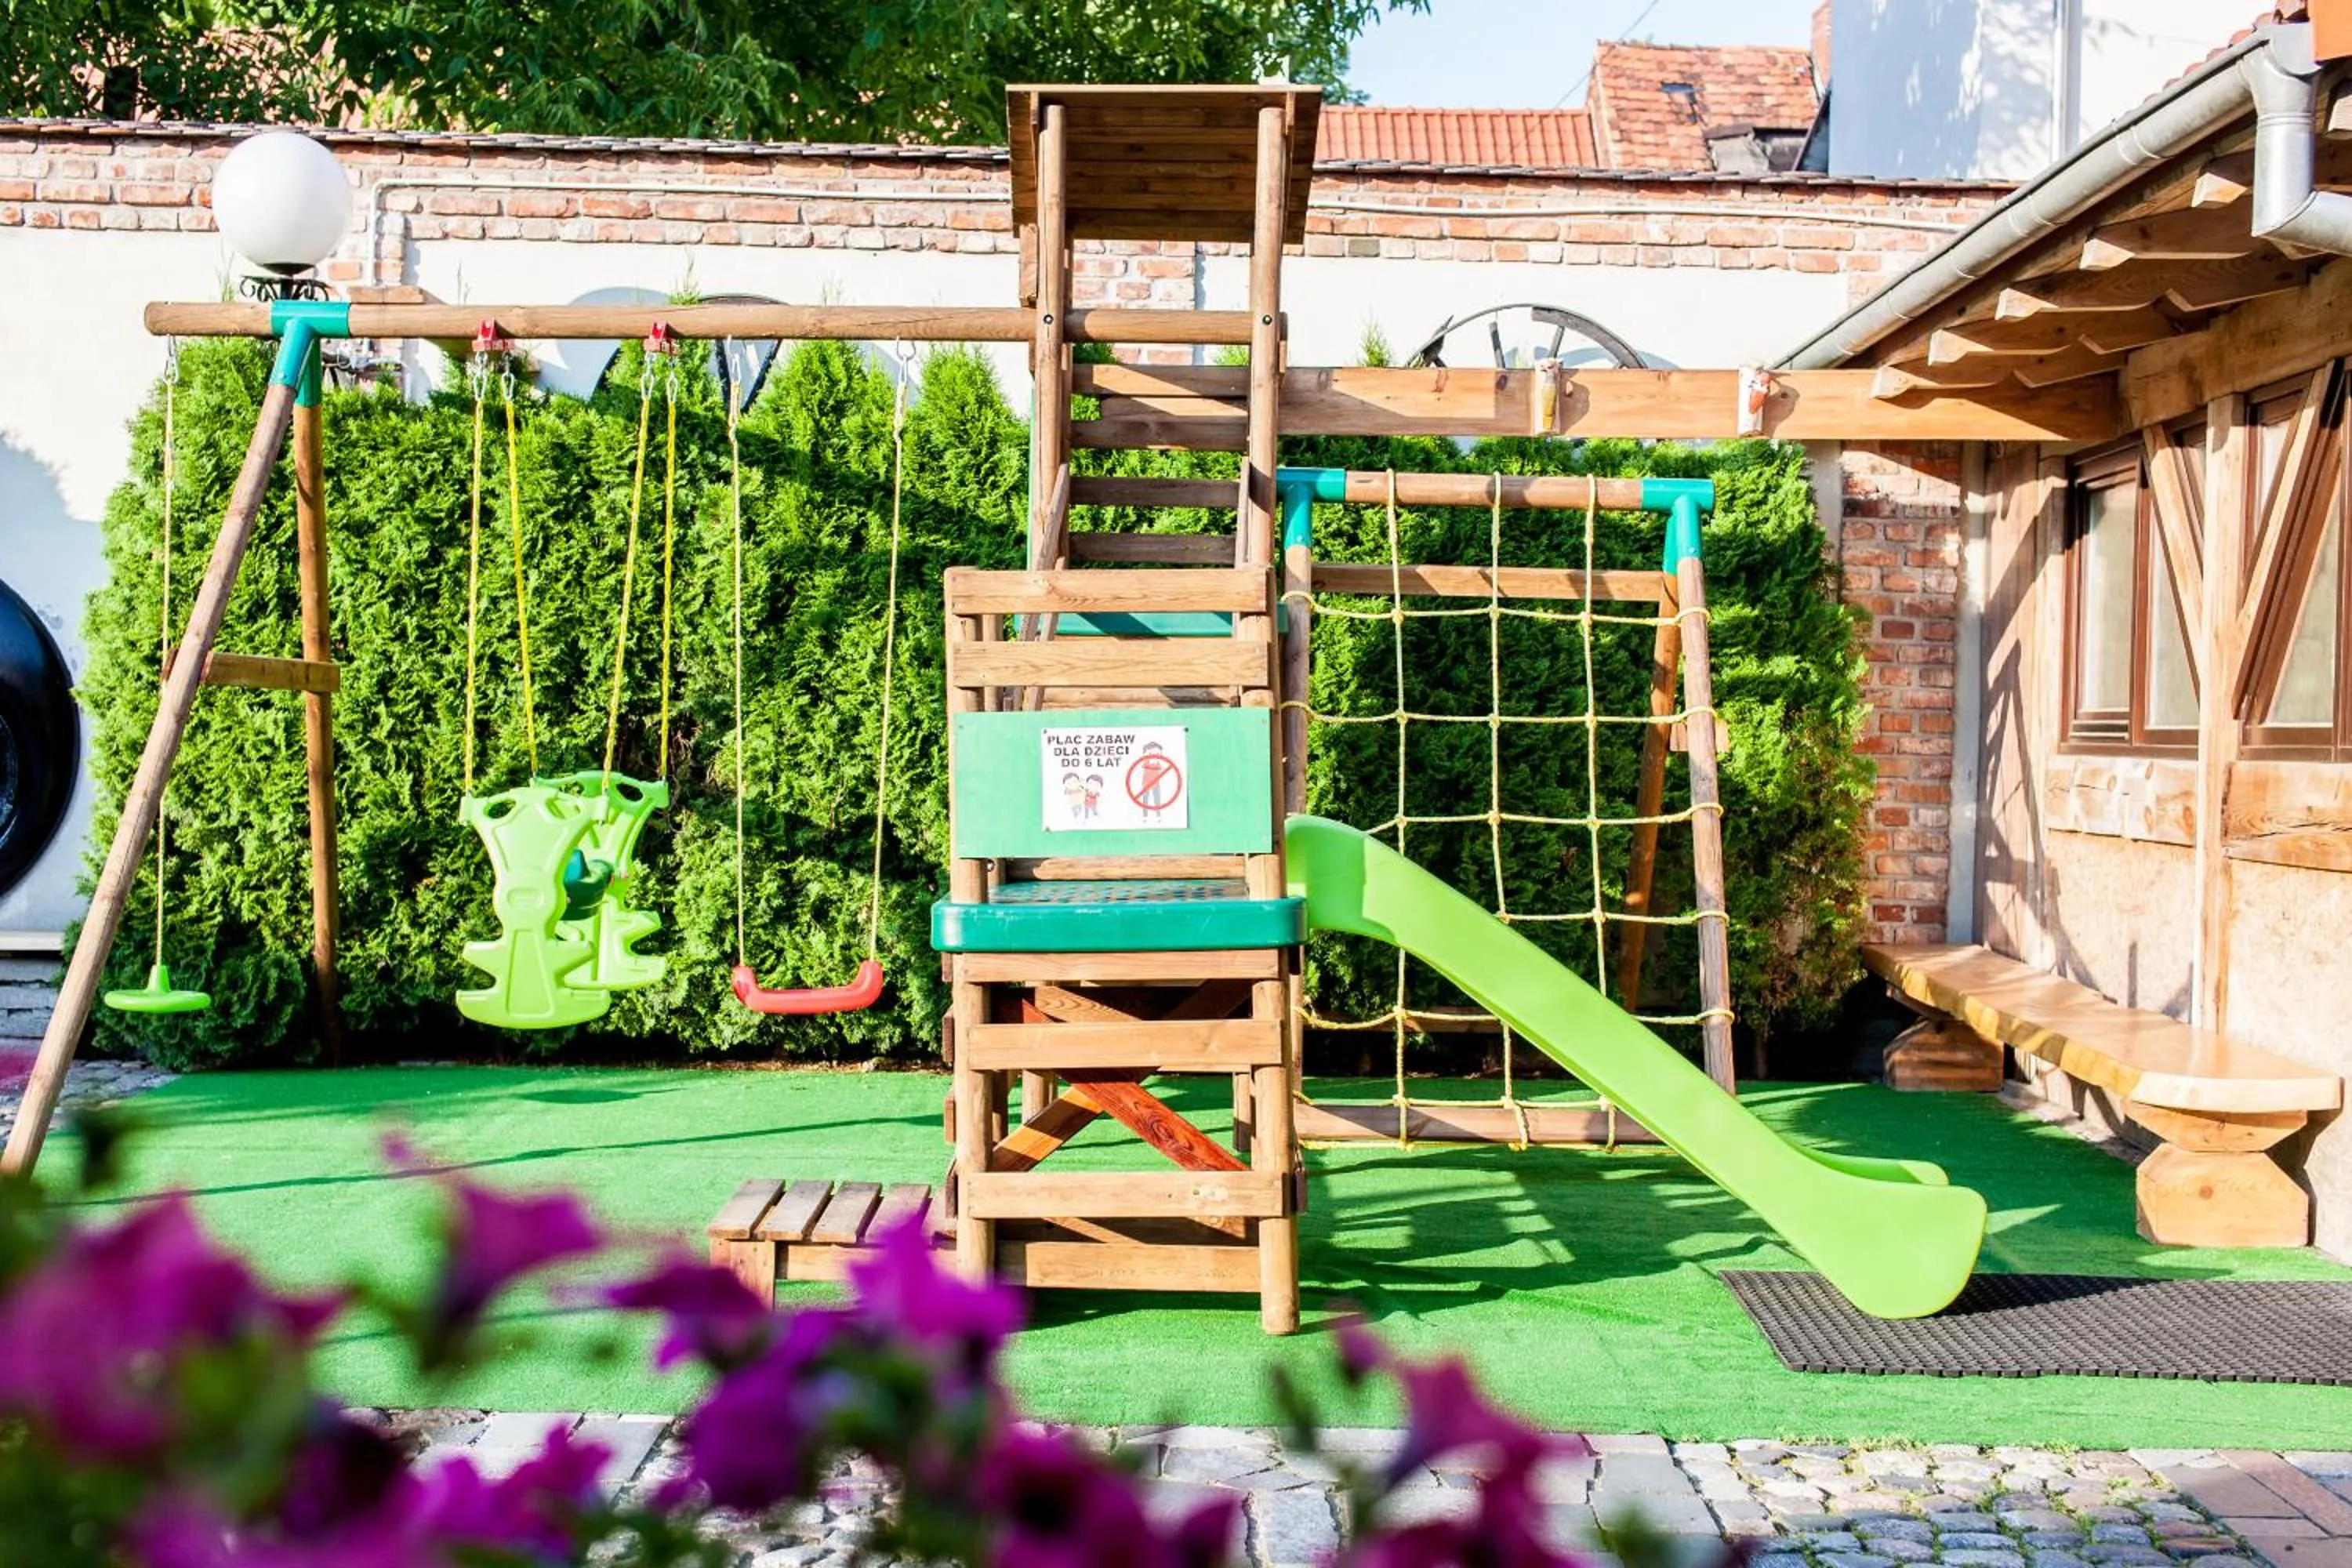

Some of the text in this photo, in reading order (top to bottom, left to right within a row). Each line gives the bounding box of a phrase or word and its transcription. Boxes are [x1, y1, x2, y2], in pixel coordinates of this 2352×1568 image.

[1047, 735, 1135, 745] PLAC ZABAW
[1054, 746, 1130, 757] DLA DZIECI
[1061, 757, 1121, 768] DO 6 LAT
